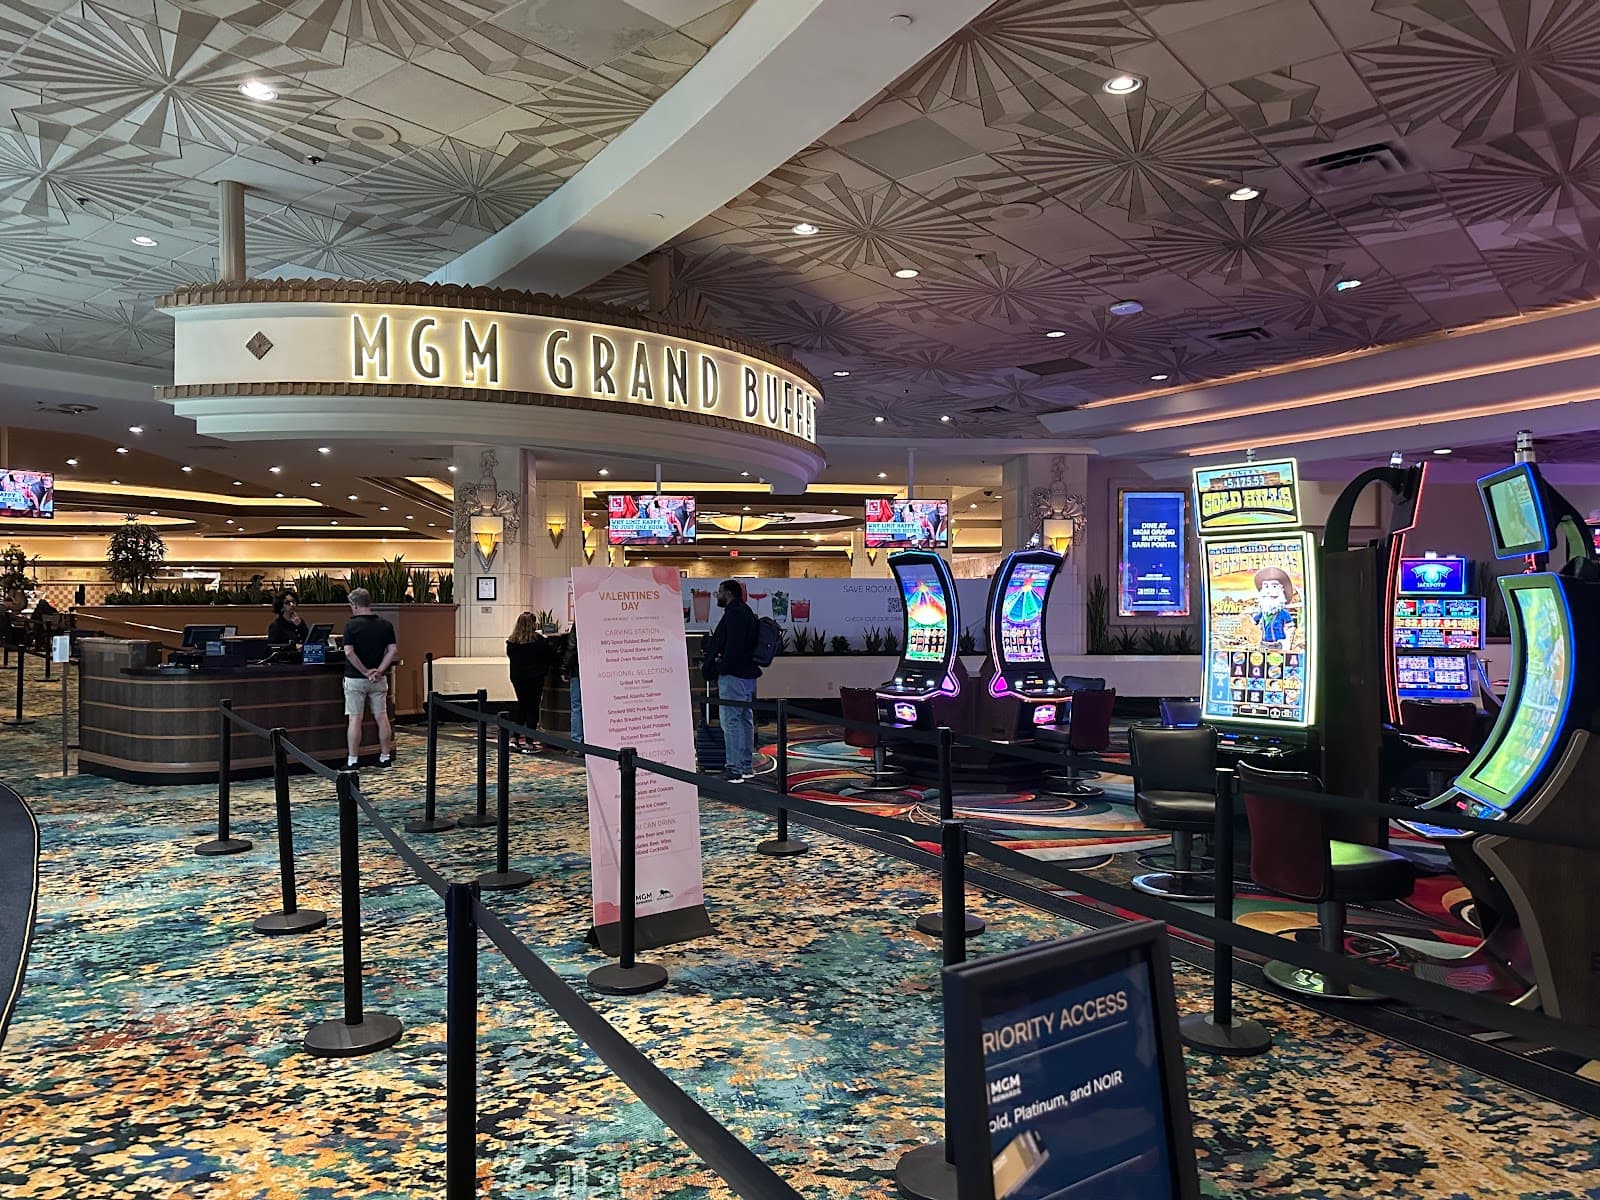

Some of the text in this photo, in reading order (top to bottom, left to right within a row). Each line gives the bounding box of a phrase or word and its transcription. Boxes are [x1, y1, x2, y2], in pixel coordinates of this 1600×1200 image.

[352, 315, 499, 384] MGM
[545, 329, 719, 410] GRAND
[599, 590, 660, 600] VALENTINE'S
[621, 602, 639, 611] DAY
[598, 667, 673, 679] ADDITIONAL SELECTIONS
[637, 749, 674, 758] ELECTIONS
[636, 892, 652, 901] MGM
[982, 990, 1128, 1056] RIORITY ACCESS
[990, 1074, 1021, 1096] MGM
[989, 1070, 1123, 1133] old, Platinum, and NOIR
